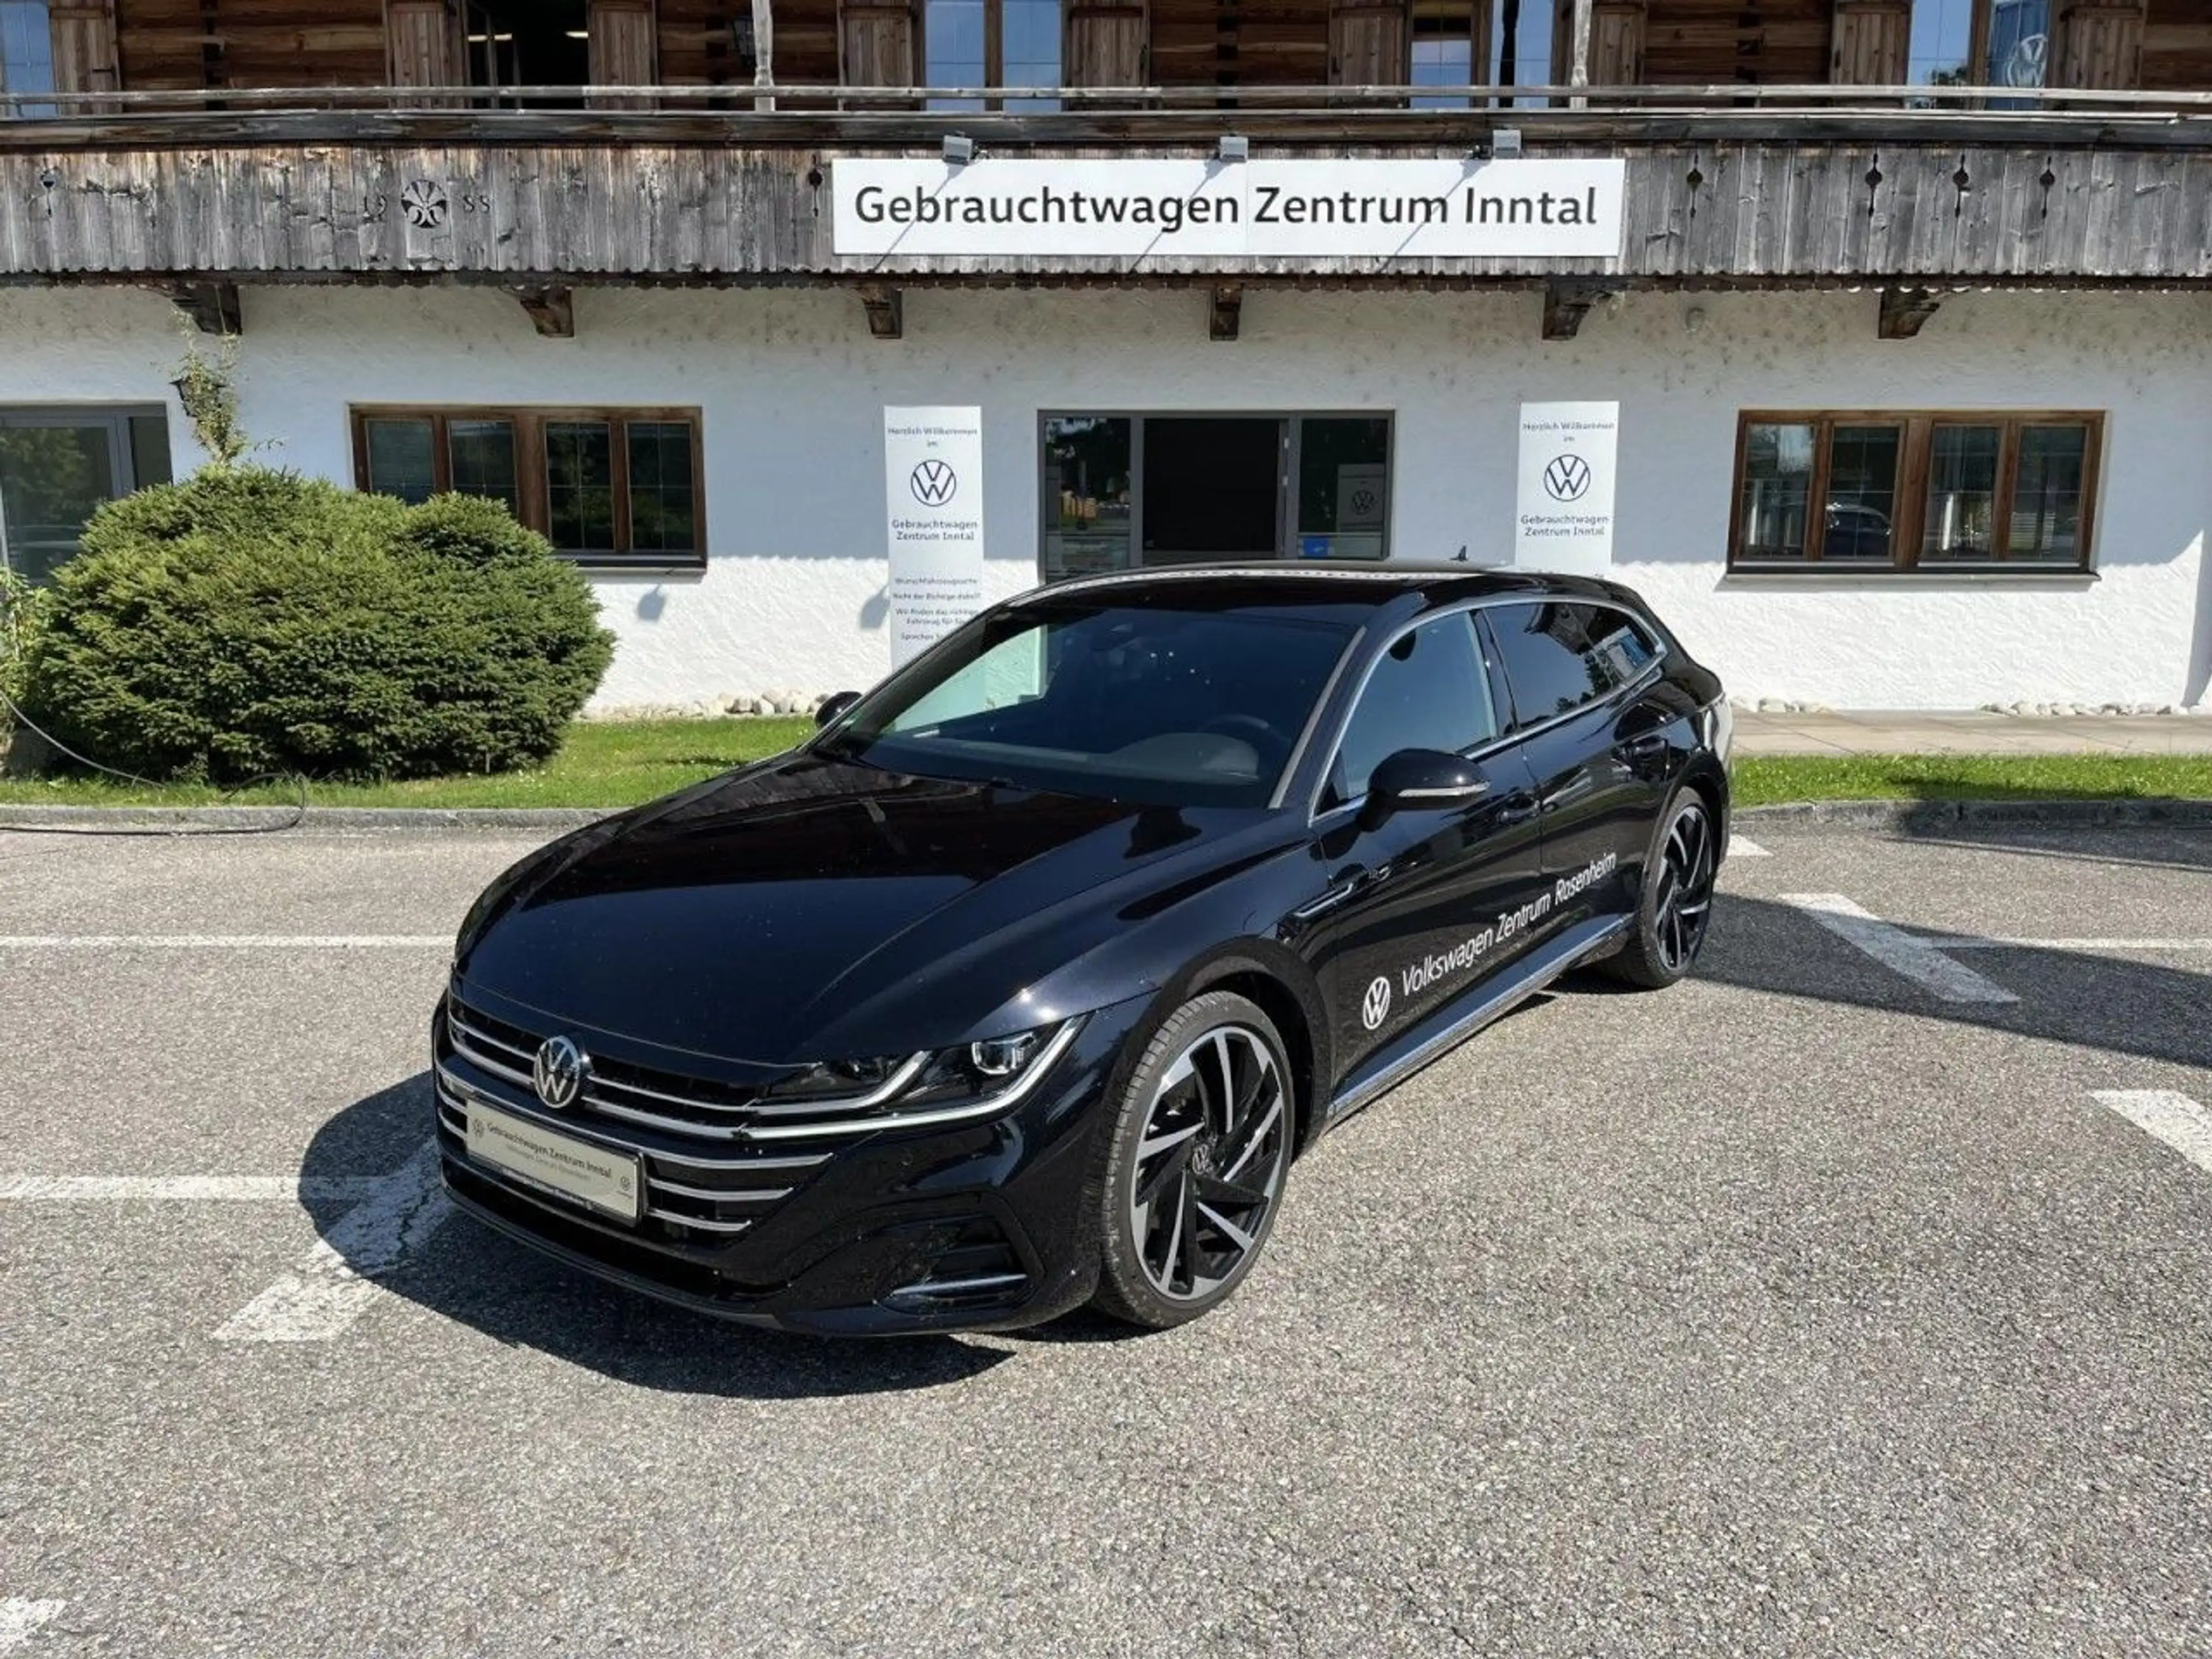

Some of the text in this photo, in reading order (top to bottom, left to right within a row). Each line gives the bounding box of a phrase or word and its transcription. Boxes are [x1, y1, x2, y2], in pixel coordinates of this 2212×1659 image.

[855, 185, 1596, 232] Gebrauchtwagen Zentrum Inntal
[911, 459, 957, 507] VW
[1544, 454, 1591, 502] VW
[892, 519, 978, 531] Gebrauchtwagen
[896, 531, 975, 540] Zentrum Inntal
[1520, 514, 1609, 525] Gebrauchtwagen
[1525, 526, 1605, 536] Zentrum Inntal
[1402, 852, 1617, 996] Volkswagen Zentrum Rosenheim
[1363, 976, 1391, 1030] VW
[534, 1035, 581, 1108] VW
[548, 1147, 585, 1169] Zentrum
